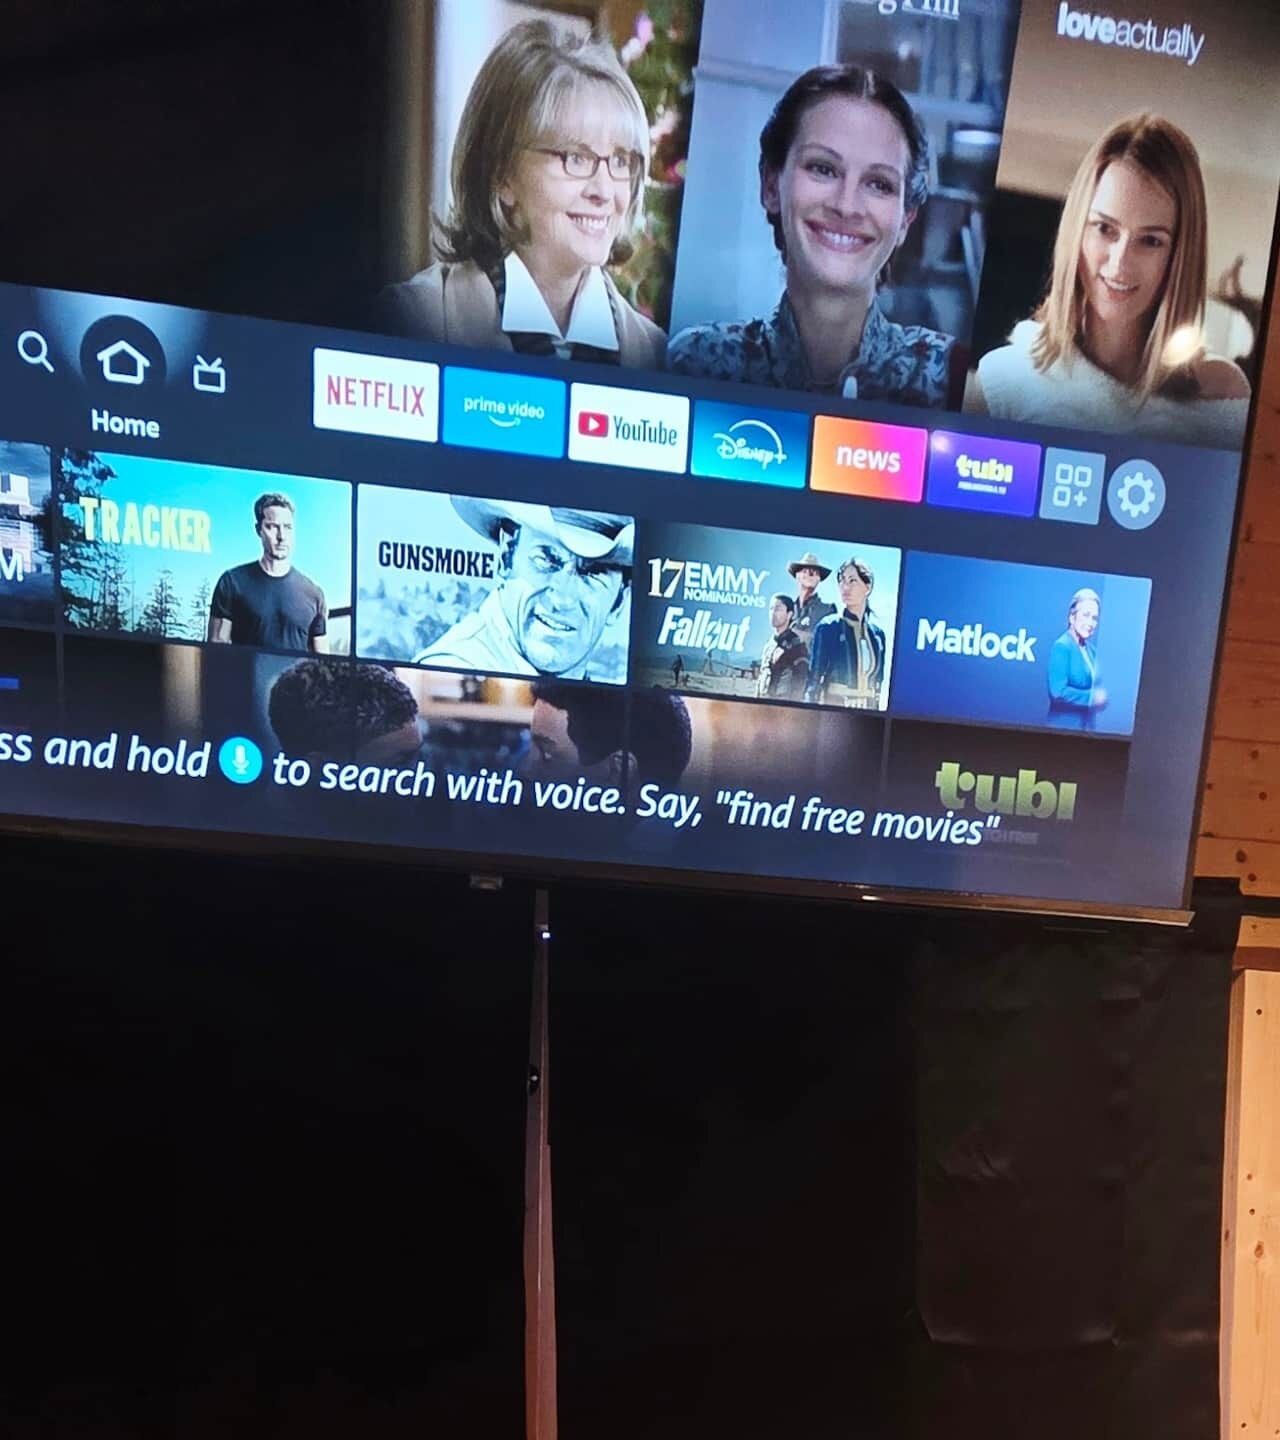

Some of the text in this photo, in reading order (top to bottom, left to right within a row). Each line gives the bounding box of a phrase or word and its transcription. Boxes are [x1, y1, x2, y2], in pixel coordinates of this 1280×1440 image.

[327, 374, 425, 417] NETFLIX
[464, 396, 545, 420] prime video
[91, 409, 161, 440] Home
[613, 415, 678, 447] YouTube
[836, 443, 901, 474] news
[956, 453, 1013, 484] tubi
[79, 496, 213, 554] TRACKER
[378, 540, 495, 580] GUNSMOKE
[647, 557, 770, 599] 17 EMMY
[683, 587, 766, 608] NOMINATIONS
[657, 606, 752, 653] Fallout
[916, 618, 1037, 663] Matlock
[43, 733, 118, 769] and
[126, 735, 212, 779] hold
[273, 751, 312, 787] to
[319, 761, 436, 797] search
[447, 769, 523, 805] with
[533, 781, 625, 816] voice.
[636, 783, 702, 827] Say,
[715, 790, 792, 830] "find
[800, 796, 867, 835] free
[872, 812, 1001, 846] movies"
